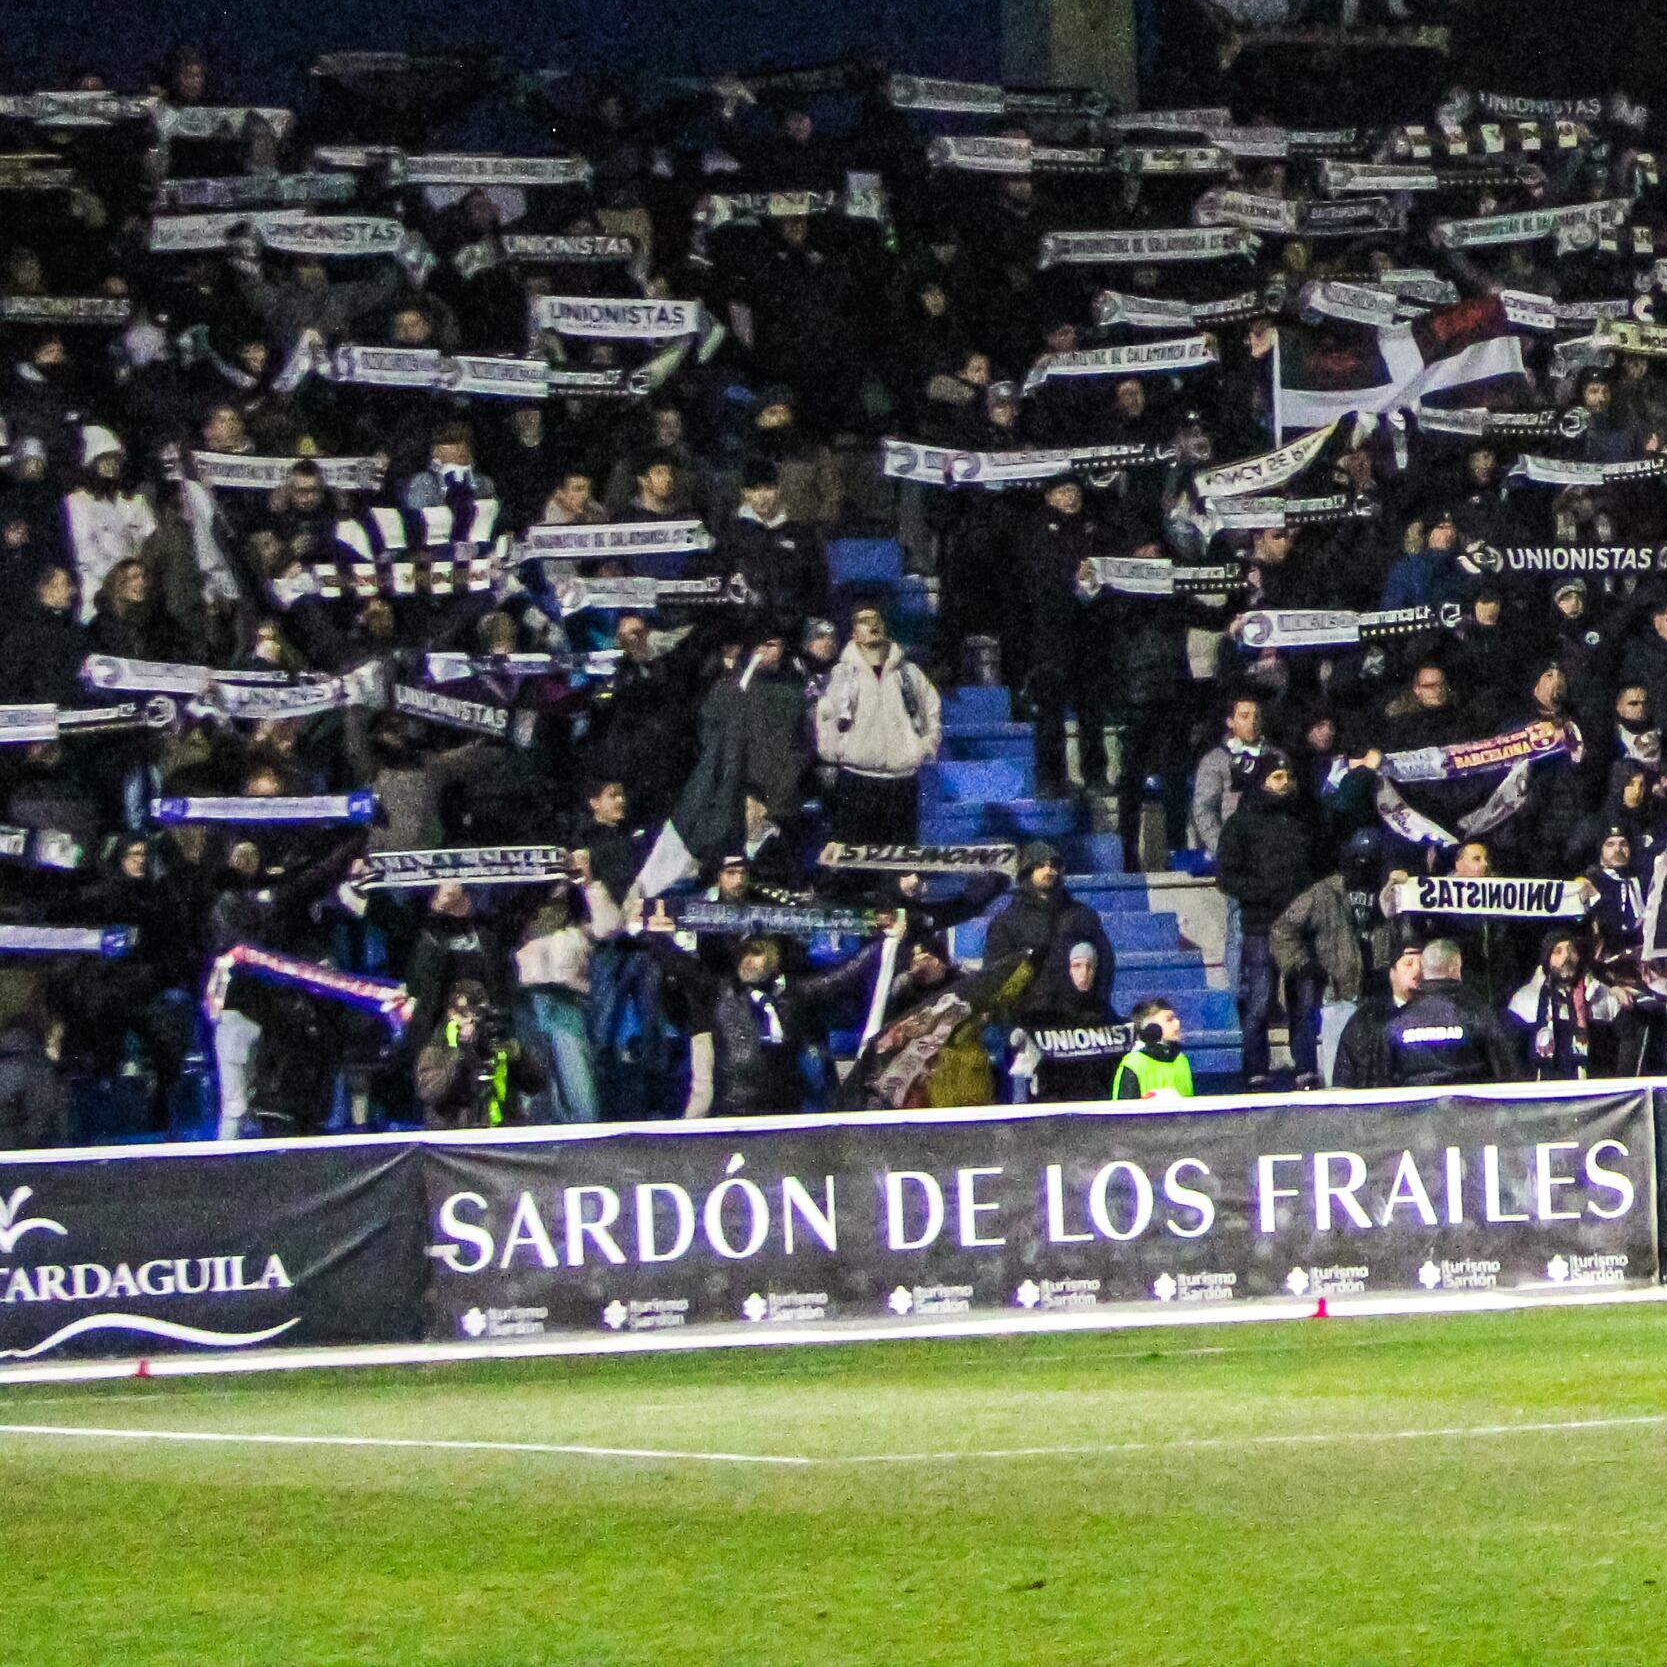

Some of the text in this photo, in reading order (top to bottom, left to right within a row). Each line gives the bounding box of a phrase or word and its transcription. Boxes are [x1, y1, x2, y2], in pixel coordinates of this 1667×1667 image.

[548, 302, 686, 325] UNIONISTAS
[1510, 546, 1653, 571] UNIONISTAS
[1453, 738, 1531, 770] BARCELONA
[1035, 1021, 1136, 1051] UNIONIST
[437, 1138, 1635, 1274] SARDÓN DE LOS FRAILES
[1442, 1259, 1501, 1273] turismo
[1571, 1253, 1629, 1267] turismo
[0, 1254, 293, 1304] ARDAGUILA
